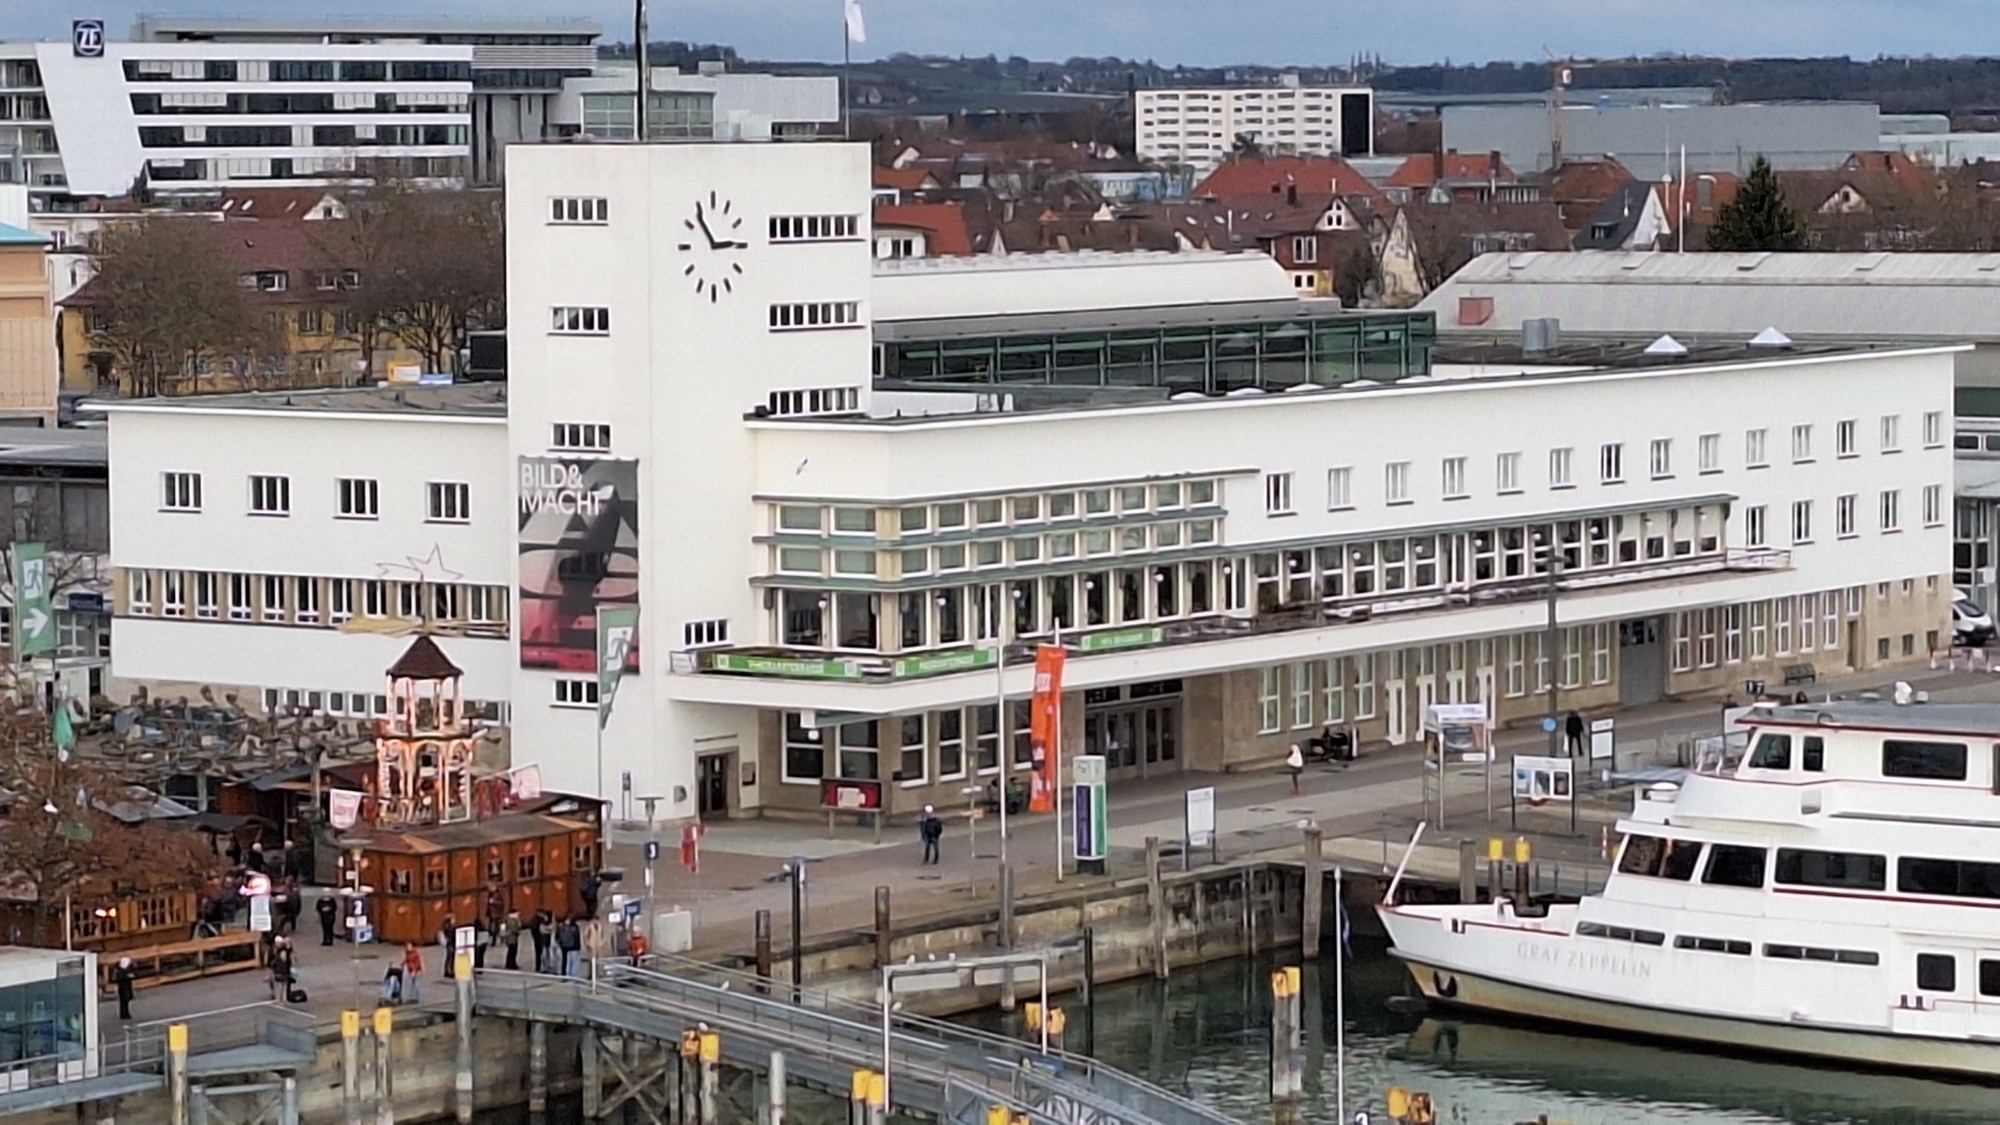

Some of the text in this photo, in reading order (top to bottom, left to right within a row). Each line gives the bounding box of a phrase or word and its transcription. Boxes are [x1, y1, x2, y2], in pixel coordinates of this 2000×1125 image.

[76, 27, 102, 49] ZF
[521, 463, 584, 489] BILD&
[521, 489, 601, 516] MACHT
[1517, 940, 1652, 978] GRAF ZEPPELIN
